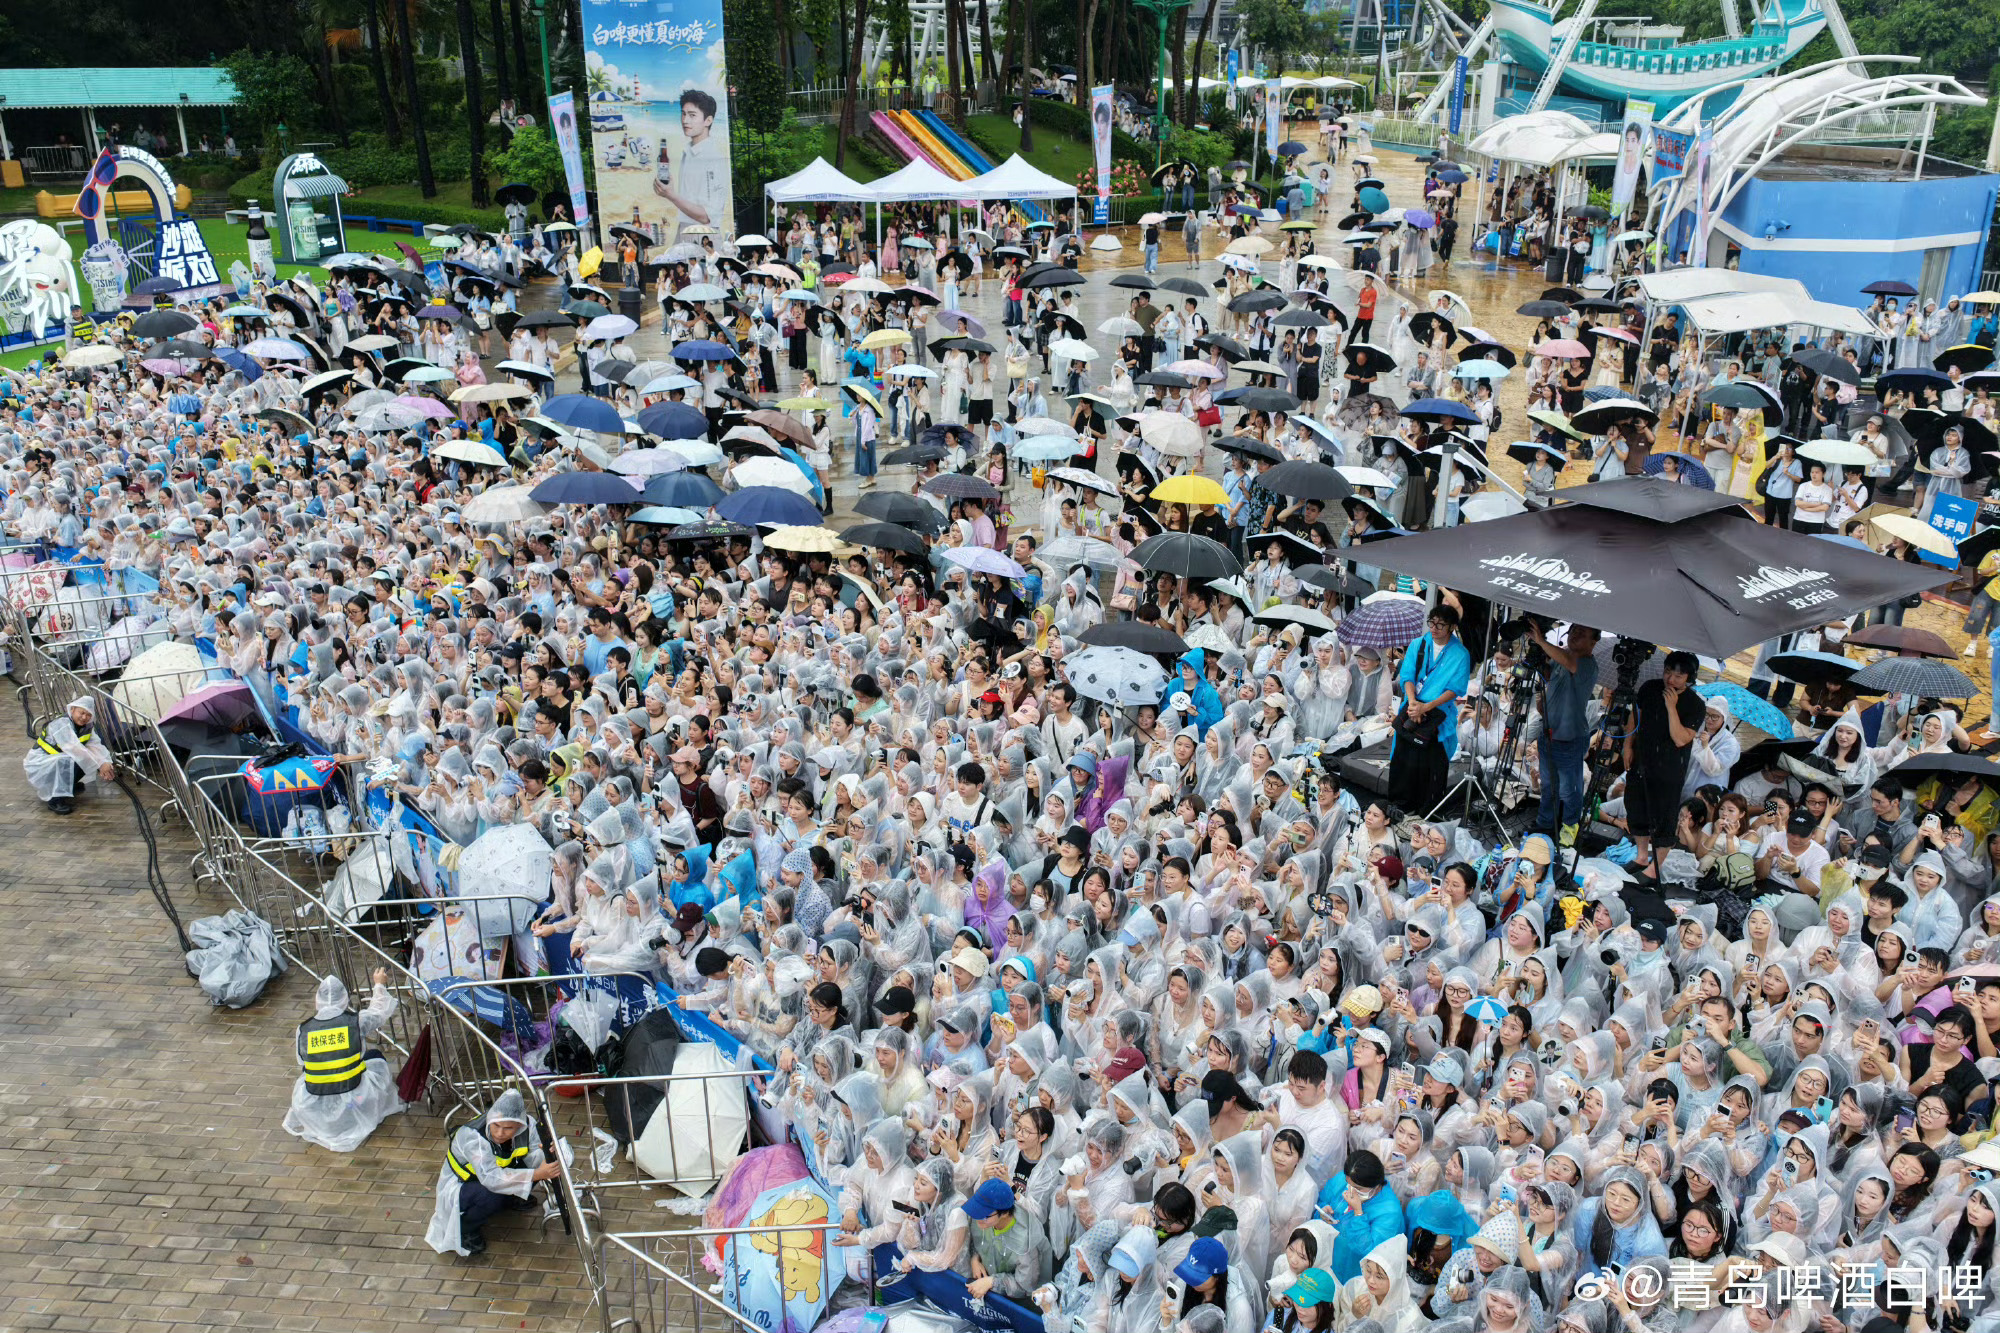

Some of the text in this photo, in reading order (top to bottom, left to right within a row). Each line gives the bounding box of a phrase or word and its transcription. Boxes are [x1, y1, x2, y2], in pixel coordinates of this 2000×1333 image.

[592, 19, 708, 48] 白啤更懂夏的嗨
[161, 220, 206, 258] 沙滩
[159, 251, 219, 289] 派对
[1931, 513, 1968, 535] 洗手间
[1478, 564, 1600, 599] HAPPY VALLEY
[1488, 576, 1562, 601] 欢乐谷
[1756, 577, 1836, 604] HAPPY VALLEY
[1786, 588, 1839, 610] 欢乐谷
